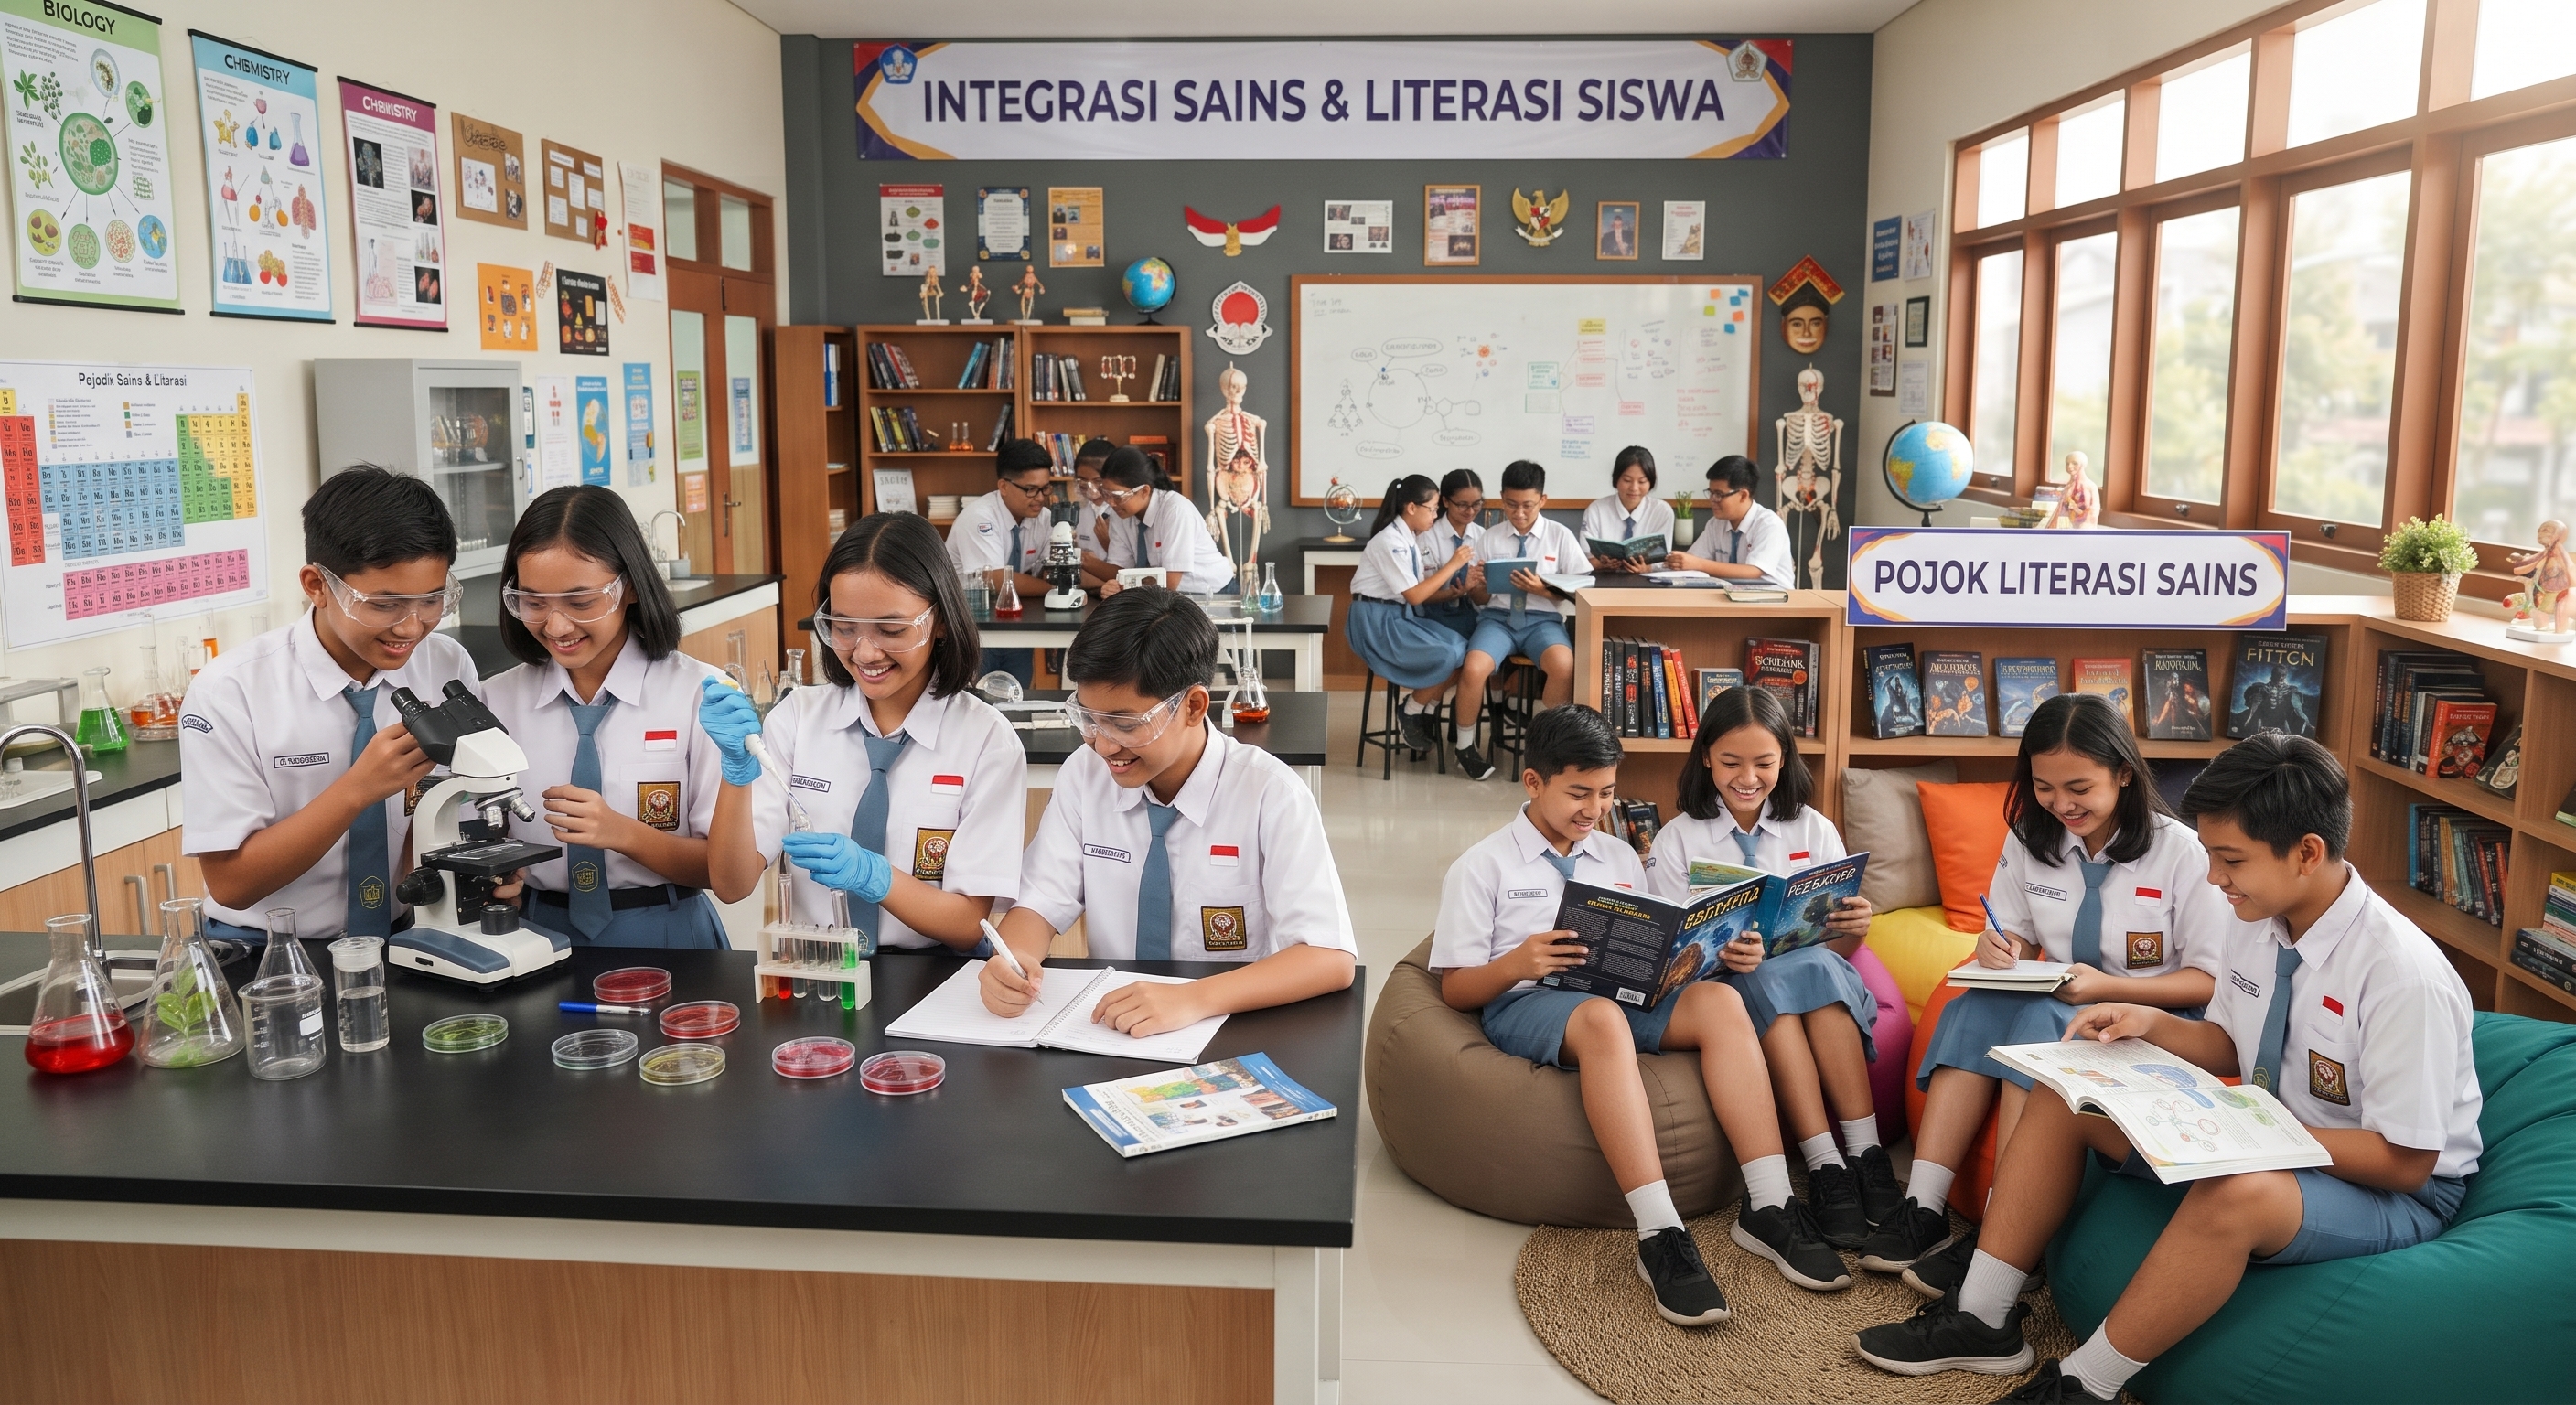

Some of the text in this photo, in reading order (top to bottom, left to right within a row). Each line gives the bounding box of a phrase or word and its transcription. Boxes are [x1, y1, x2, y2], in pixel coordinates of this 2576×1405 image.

[42, 0, 115, 35] BIOLOGY
[924, 79, 1725, 123] INTEGRASI SAINS & LITERASI SISWA
[116, 373, 143, 386] Sains
[145, 373, 152, 386] &
[1874, 559, 2258, 597] POJOK LITERASI SAINS
